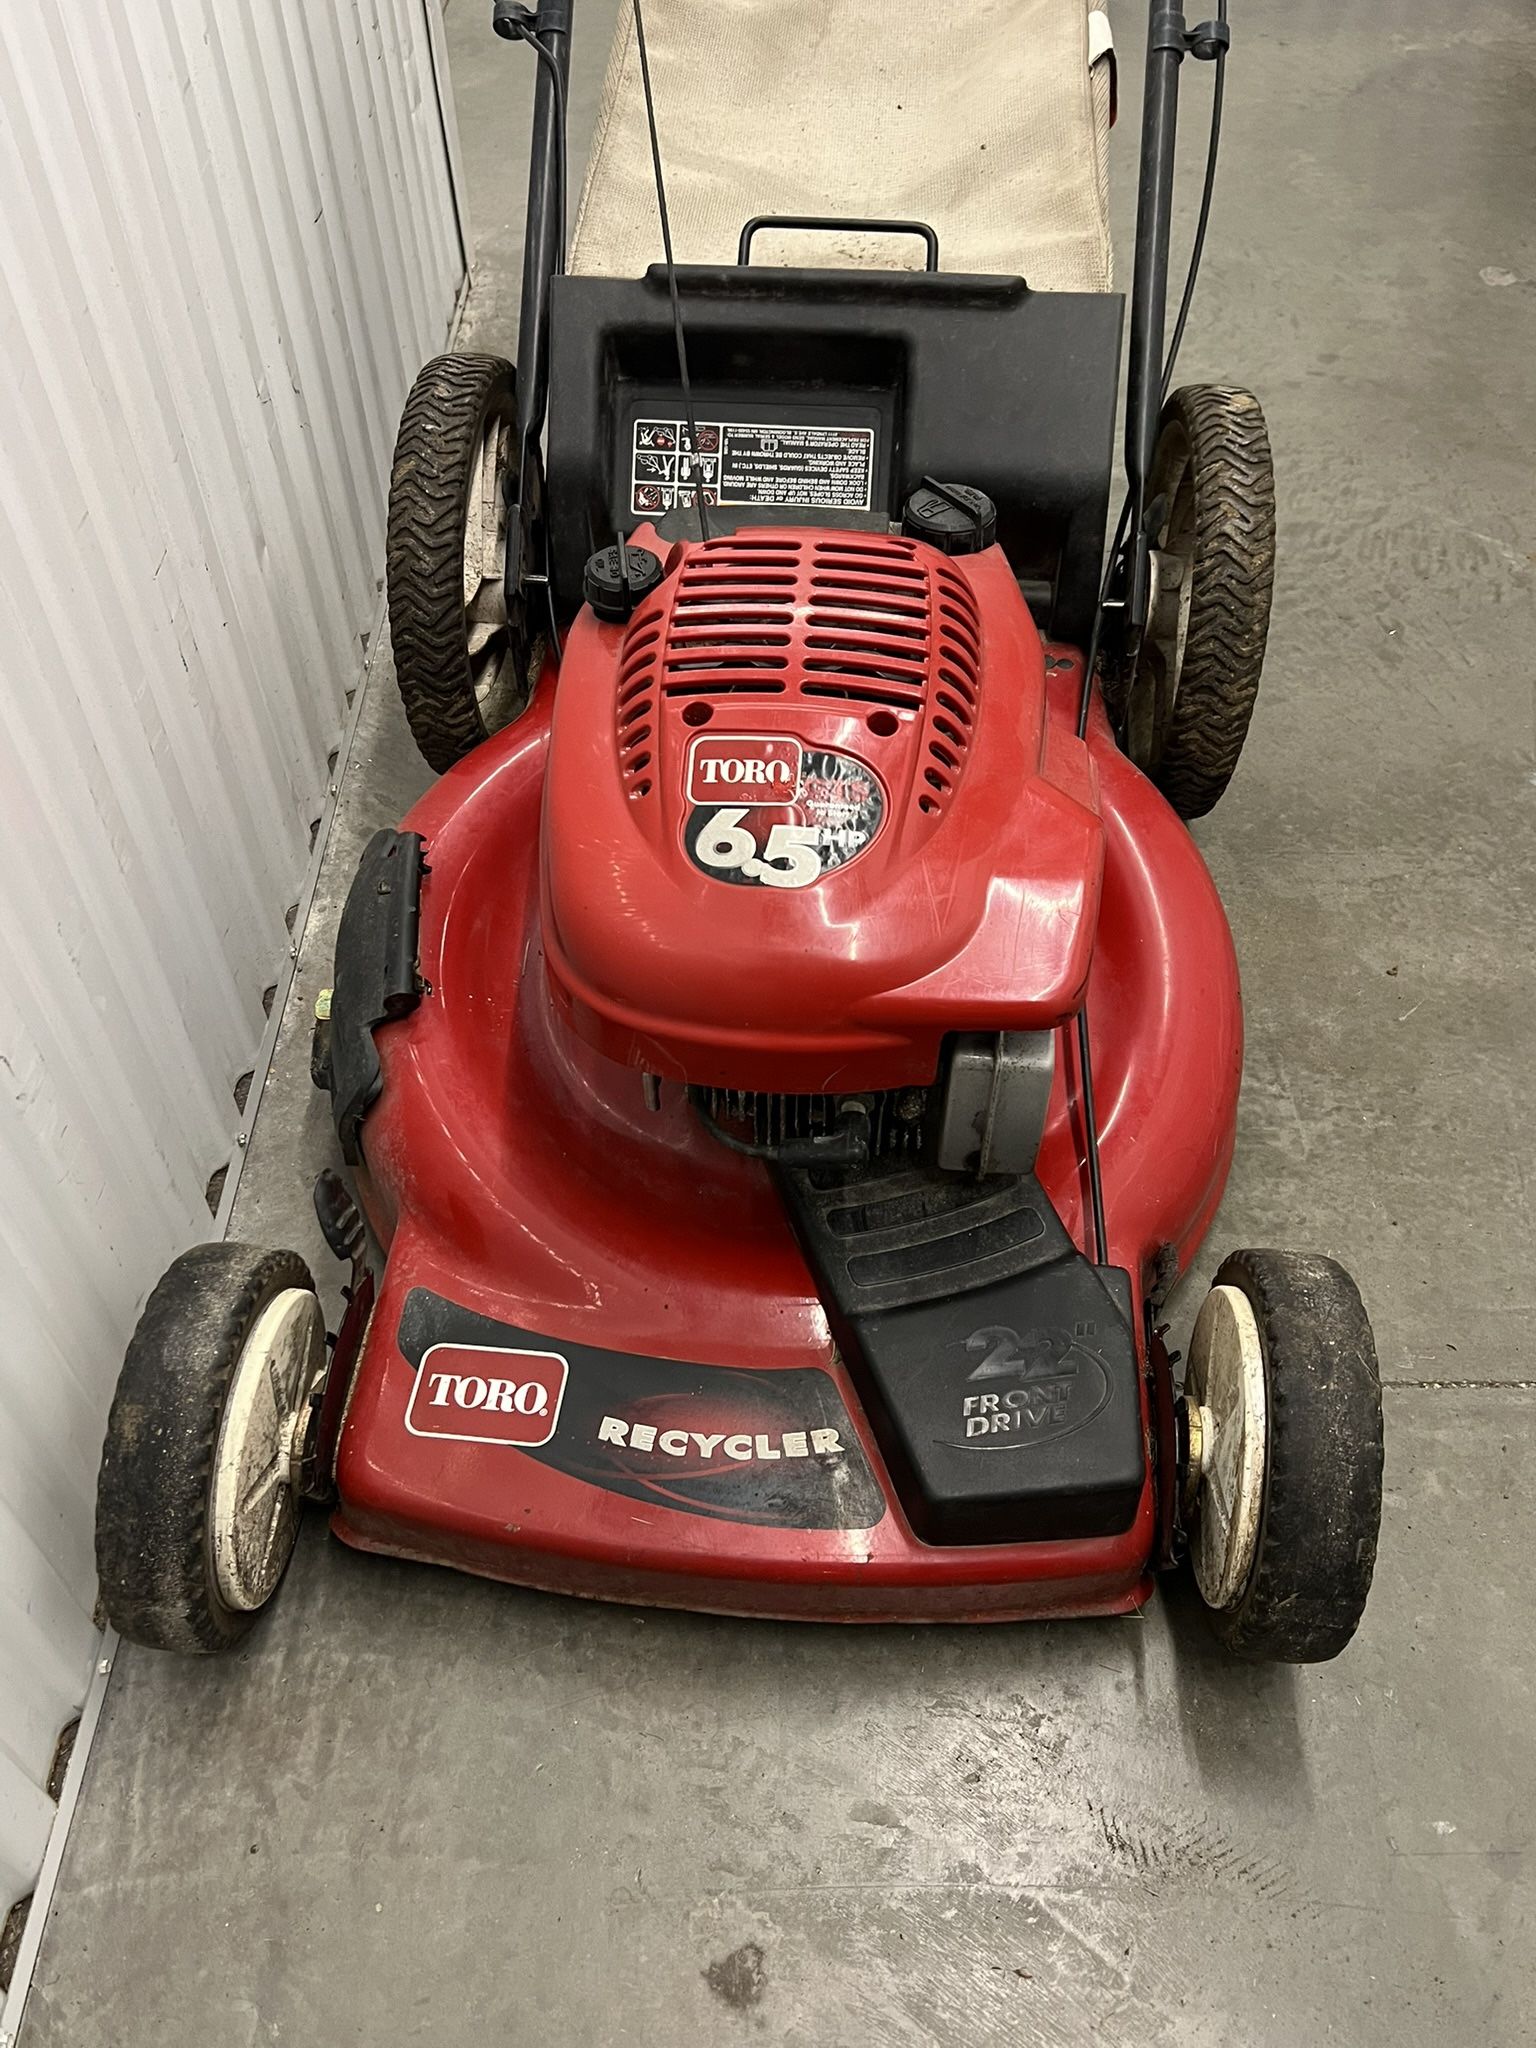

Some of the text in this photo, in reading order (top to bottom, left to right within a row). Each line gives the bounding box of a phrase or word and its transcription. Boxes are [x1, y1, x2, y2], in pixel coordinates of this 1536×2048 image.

[784, 496, 810, 504] INJURY
[700, 759, 790, 784] TORO
[696, 808, 868, 888] 6.5 HP
[963, 1379, 1073, 1417] FRONT
[597, 1415, 845, 1461] RECYCLER
[964, 1402, 1067, 1438] DRIVE
